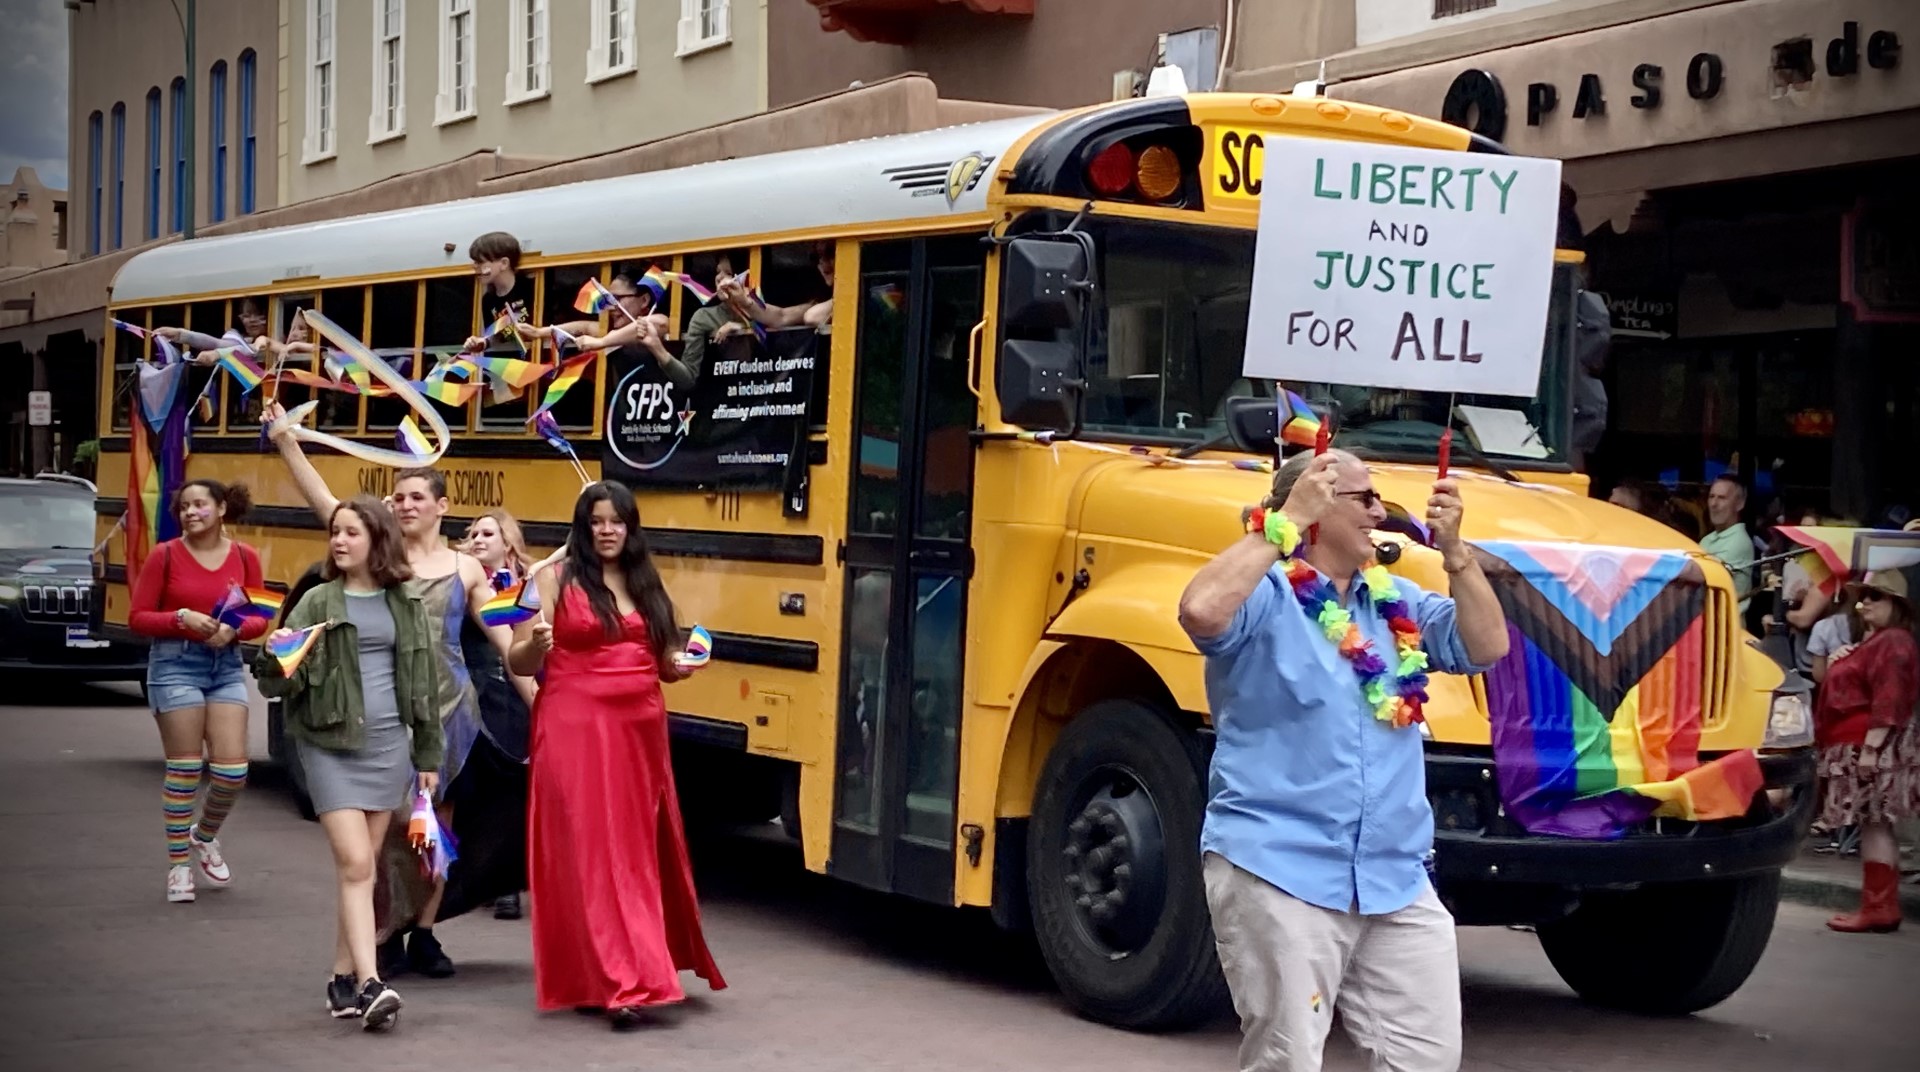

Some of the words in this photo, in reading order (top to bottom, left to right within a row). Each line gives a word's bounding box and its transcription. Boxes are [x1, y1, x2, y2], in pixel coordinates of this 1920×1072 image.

[1527, 53, 1724, 126] PASO
[1826, 21, 1898, 77] de
[1314, 158, 1518, 214] LIBERTY
[1368, 219, 1429, 247] AND
[1313, 251, 1495, 300] JUSTICE
[1287, 310, 1358, 352] FOR
[1390, 311, 1483, 364] ALL
[713, 360, 739, 376] EVERY
[739, 357, 774, 373] student
[774, 356, 815, 371] deserves
[626, 381, 674, 421] SFPS
[727, 385, 738, 397] an
[738, 380, 775, 396] inclusive
[774, 377, 793, 393] and
[712, 403, 750, 422] affirming
[749, 401, 806, 417] environment
[453, 470, 505, 507] SCHOOLS
